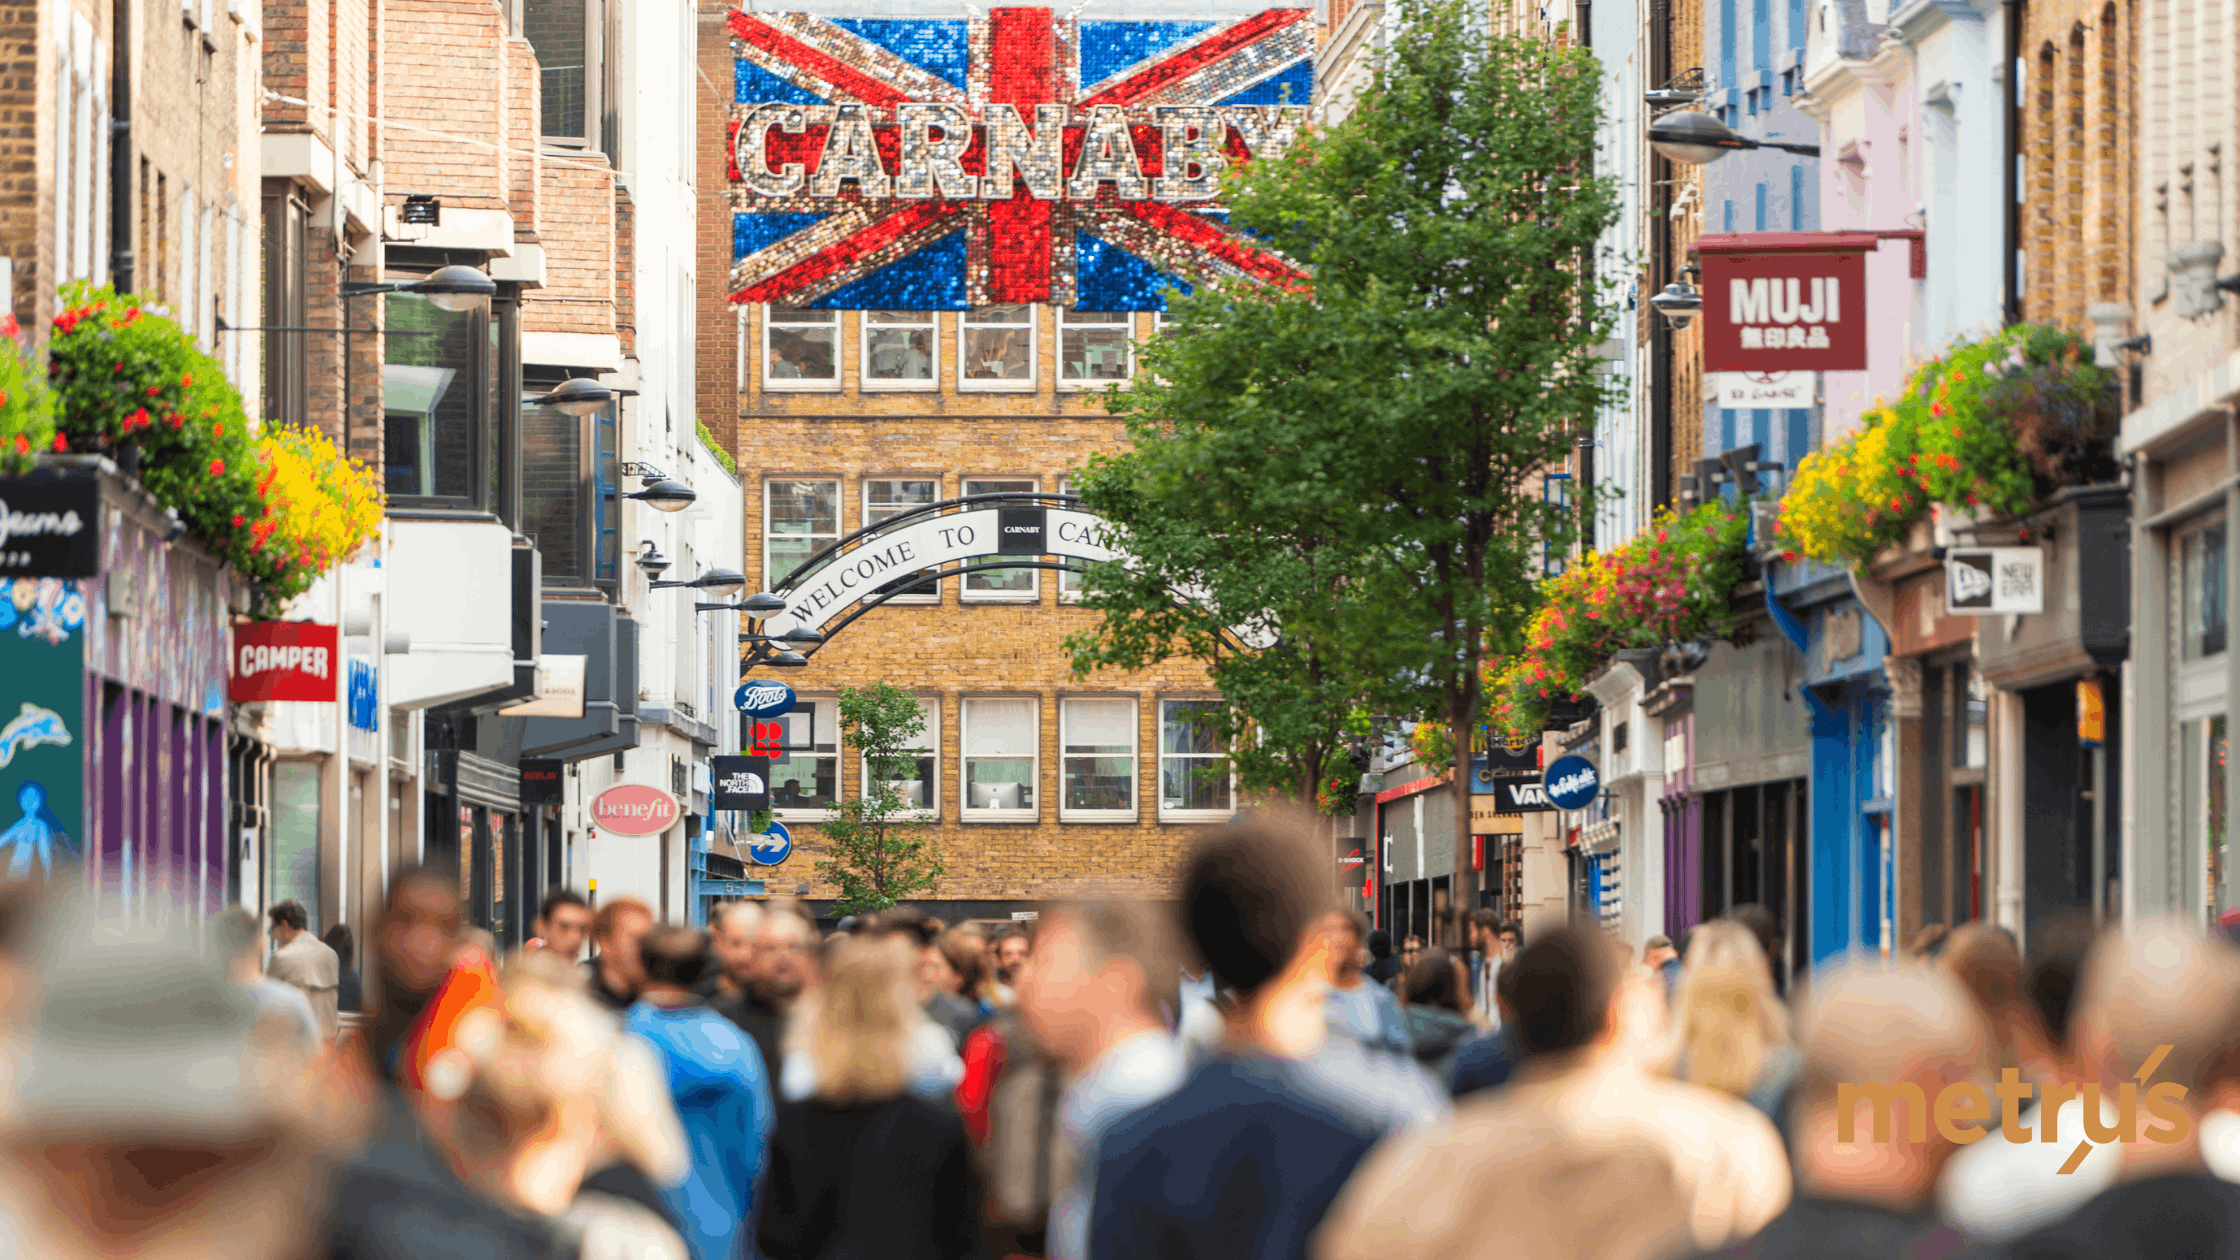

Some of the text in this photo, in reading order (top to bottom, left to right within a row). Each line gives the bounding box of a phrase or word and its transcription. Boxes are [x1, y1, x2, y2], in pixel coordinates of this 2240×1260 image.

[734, 101, 1308, 199] CARNABY
[1729, 277, 1840, 324] MUJI
[1740, 326, 1830, 349] 無印良品
[1004, 526, 1041, 534] CARNABY
[789, 541, 915, 625] WELCOME
[938, 525, 975, 549] TO
[239, 644, 328, 680] CAMPER
[740, 686, 787, 710] Boots
[523, 771, 558, 780] REPLAY
[719, 779, 749, 787] NORTH
[732, 772, 749, 780] THE
[725, 786, 749, 794] FACE
[598, 798, 671, 822] benefit
